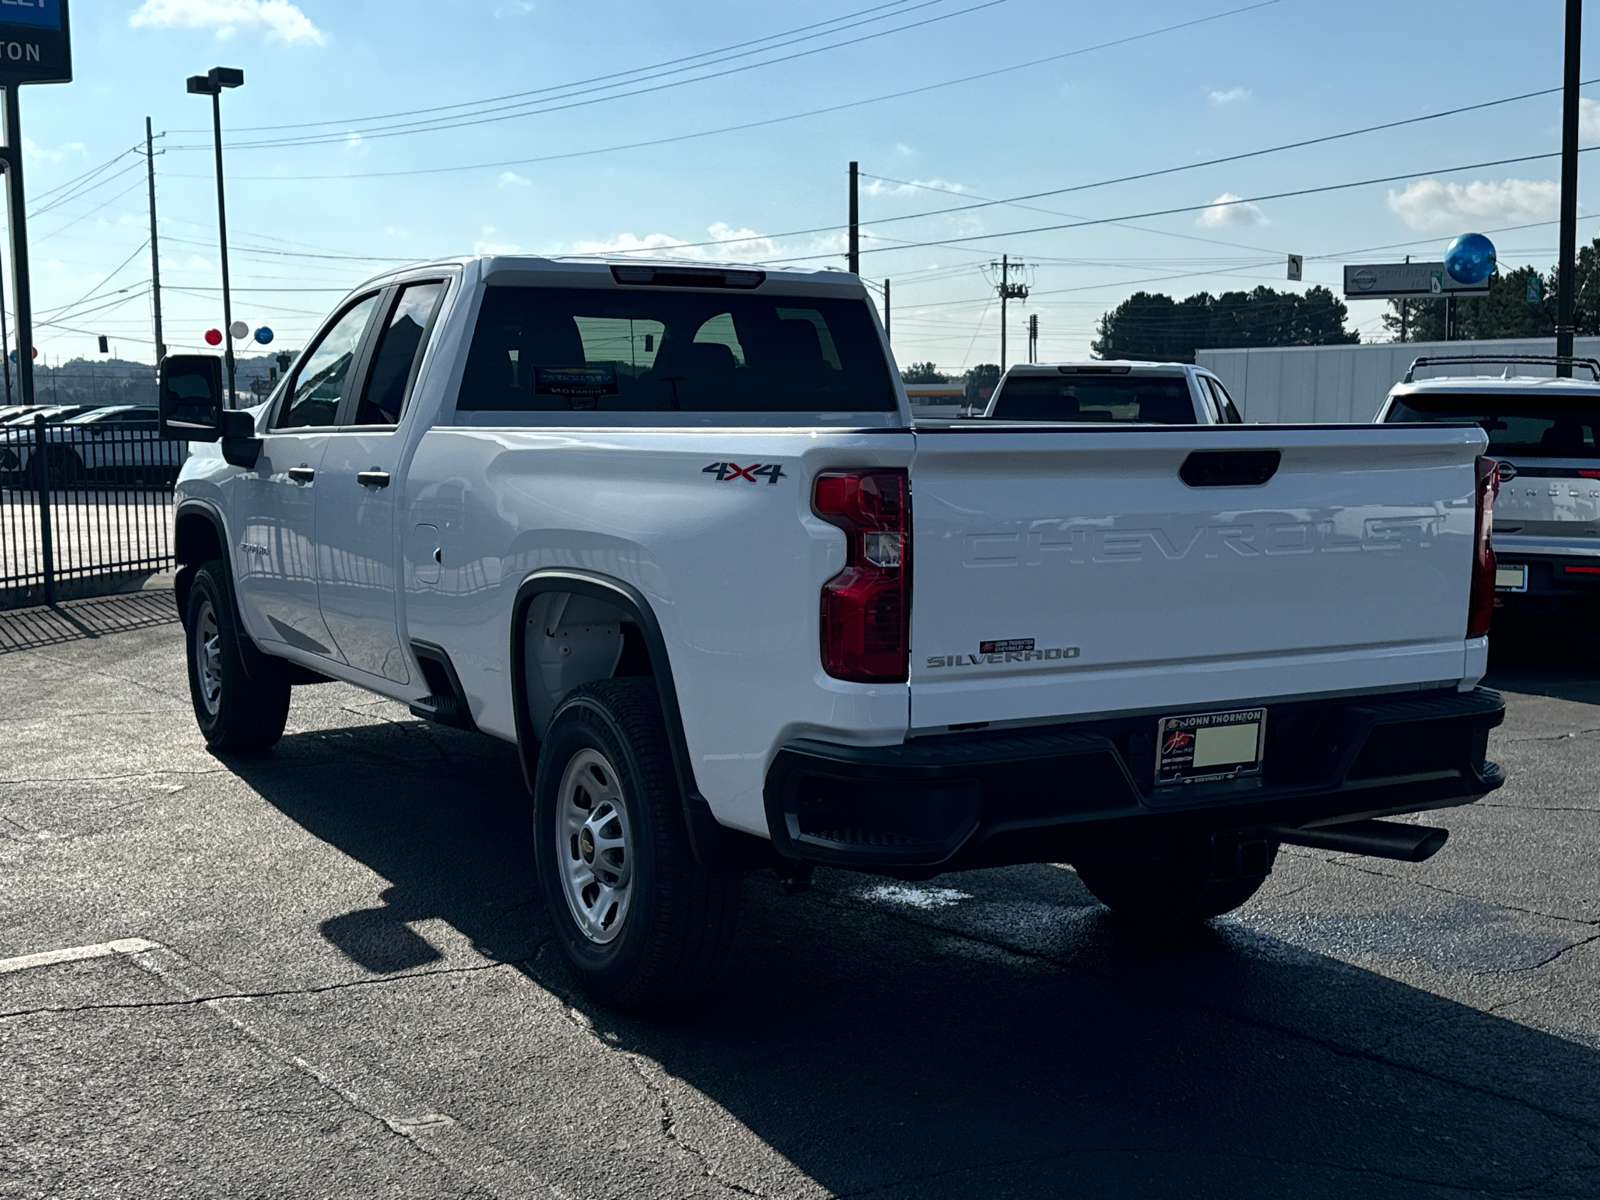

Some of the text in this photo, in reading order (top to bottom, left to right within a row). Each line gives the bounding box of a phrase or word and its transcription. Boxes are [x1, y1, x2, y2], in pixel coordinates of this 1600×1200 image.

[962, 514, 1446, 569] CHEVROLET
[926, 646, 1081, 669] SILVERADO
[1183, 711, 1261, 727] JOHN THORNTON
